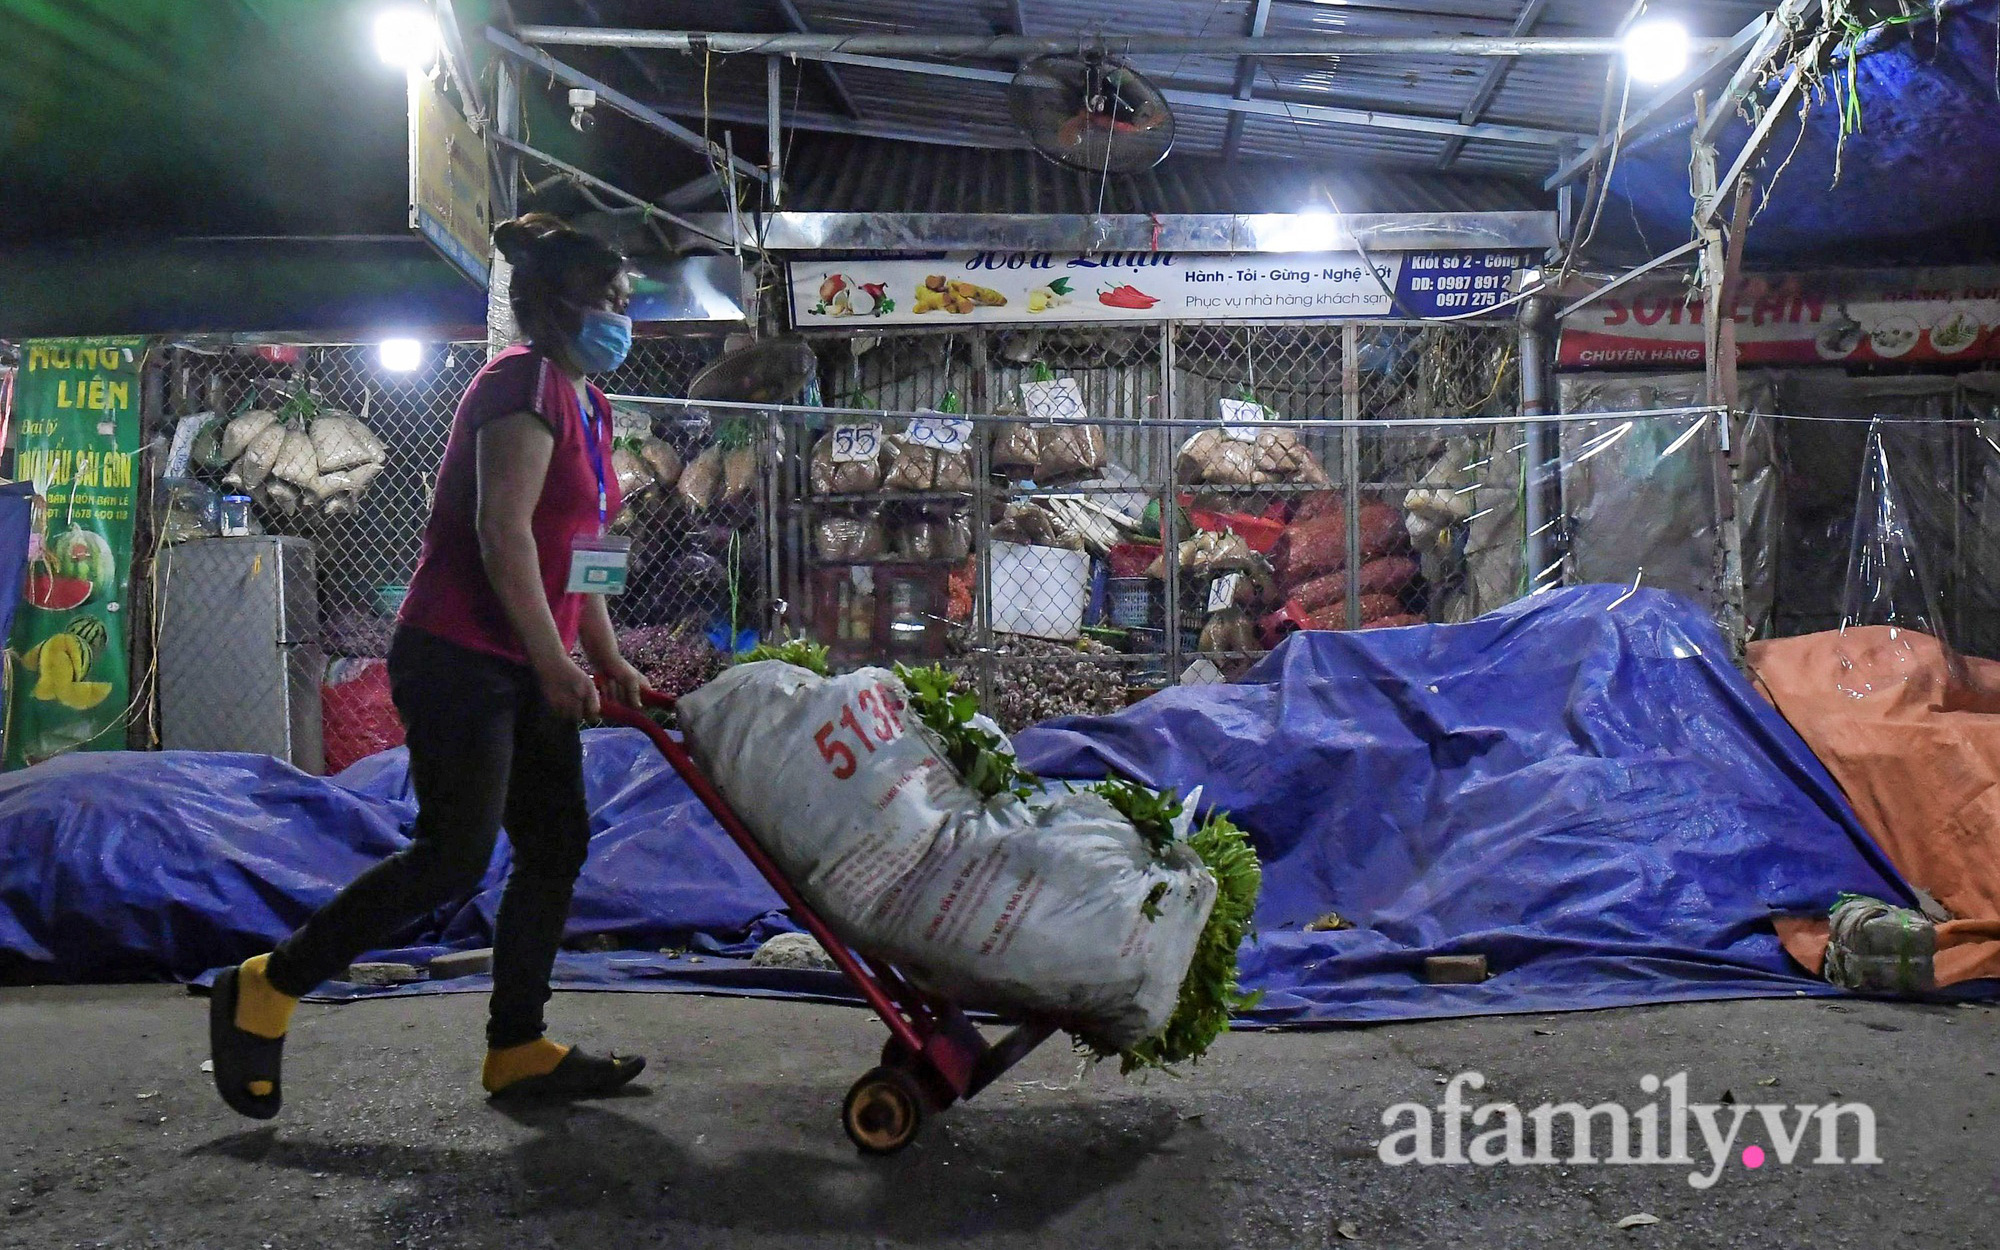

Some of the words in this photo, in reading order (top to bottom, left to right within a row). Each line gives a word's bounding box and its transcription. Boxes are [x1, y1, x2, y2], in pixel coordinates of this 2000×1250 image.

[1463, 255, 1472, 268] 2
[1185, 269, 1225, 282] Hành
[1237, 268, 1257, 282] Tỏi
[1269, 269, 1310, 283] Gừng
[1322, 267, 1362, 283] Nghệ
[1437, 276, 1471, 290] 0987
[1474, 276, 1499, 289] 891
[1186, 295, 1222, 309] Phục
[1225, 297, 1241, 309] vụ
[1244, 294, 1272, 306] nhà
[1275, 293, 1313, 307] hàng
[1316, 292, 1360, 305] khách
[1363, 293, 1389, 306] sạn
[1436, 293, 1469, 307] 0977
[1472, 292, 1496, 306] 275
[1580, 349, 1646, 362] CHUYÊN
[1650, 346, 1700, 361] HÀNG
[57, 375, 129, 410] LIÊN
[836, 427, 876, 455] 55
